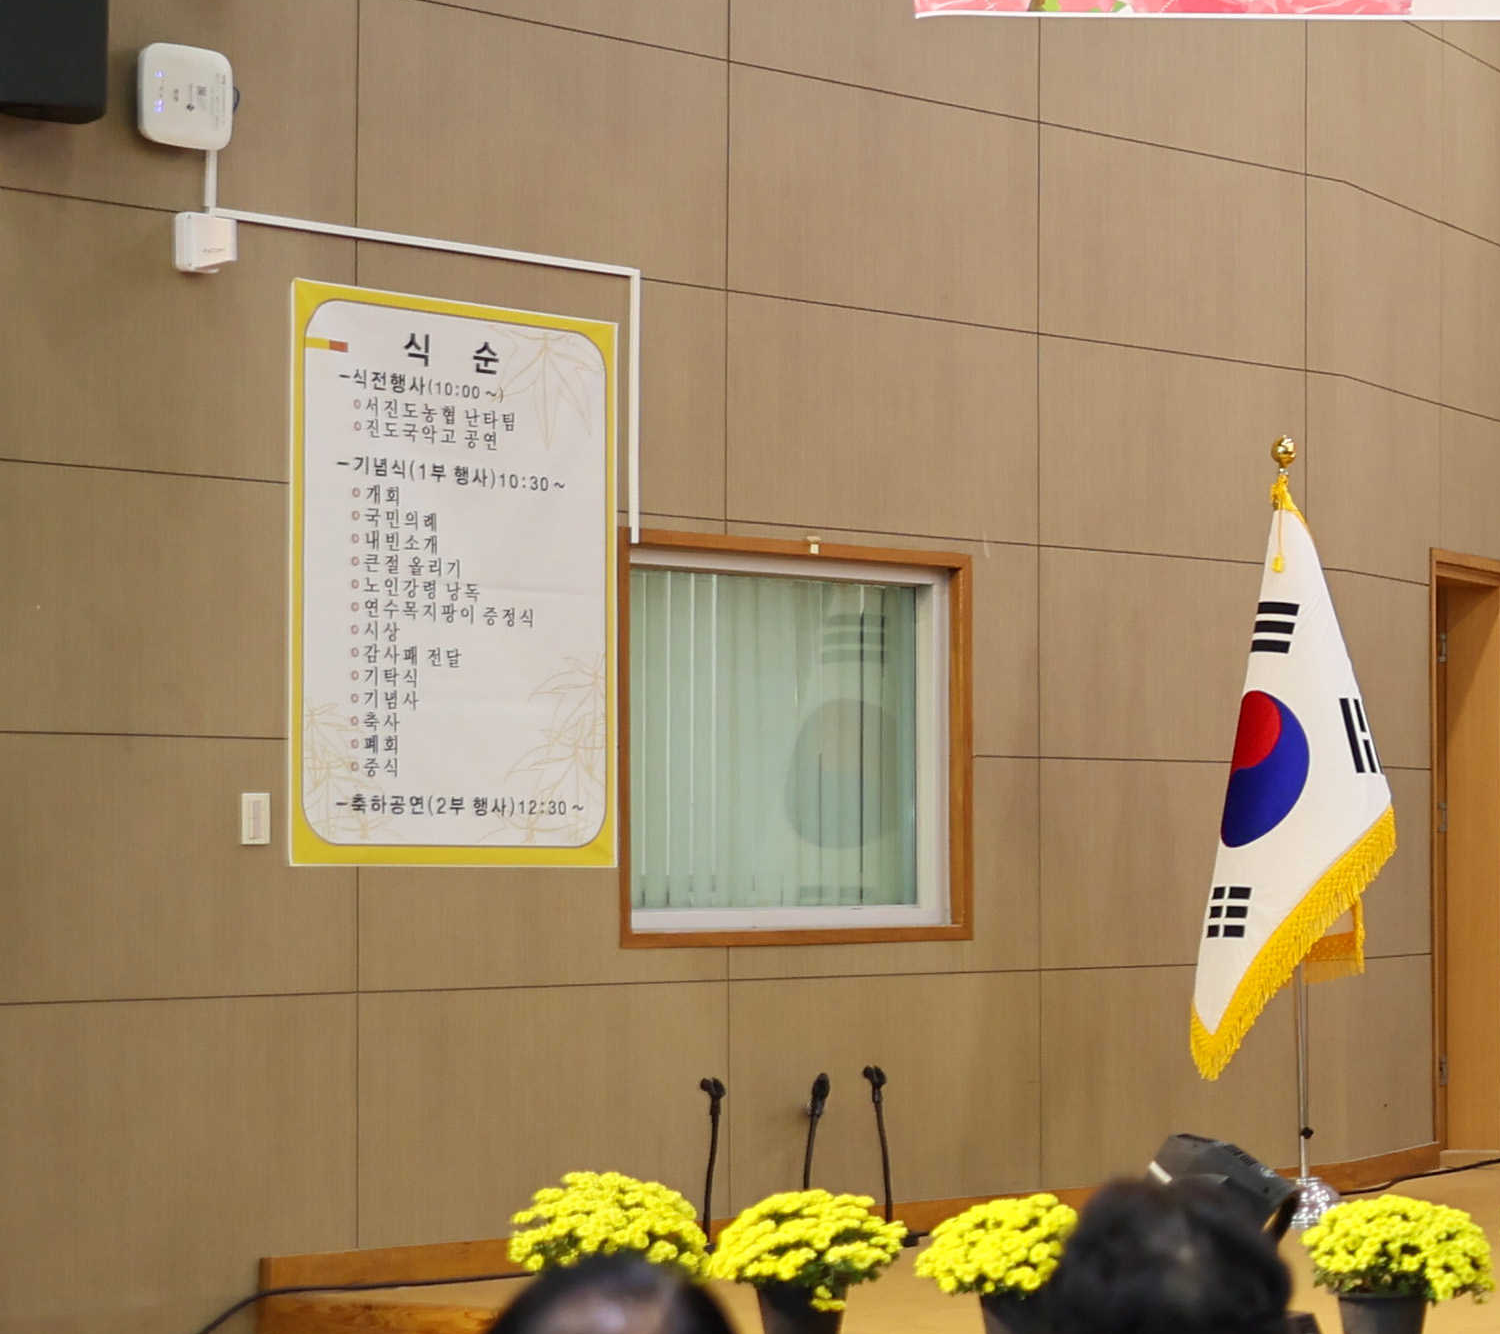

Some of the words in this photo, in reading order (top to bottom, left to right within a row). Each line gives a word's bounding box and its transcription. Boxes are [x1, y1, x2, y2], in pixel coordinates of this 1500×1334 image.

[365, 397, 456, 426] 서진도농협
[464, 408, 516, 432] 난타팀
[366, 419, 456, 445] 진도국악고
[464, 429, 499, 452] 공연
[366, 484, 400, 506] 개회
[364, 507, 438, 533] 국민의례
[365, 530, 438, 556] 내빈소개
[364, 553, 400, 574] 큰절
[408, 555, 461, 579] 올리기
[363, 576, 437, 599] 노인강령
[446, 581, 481, 603] 낭독
[364, 597, 475, 625] 연수목지팡이
[483, 606, 534, 629] 증정식
[363, 620, 400, 642] 시상
[364, 643, 418, 667] 감사패
[427, 647, 462, 668] 전달
[364, 666, 418, 688] 기탁식
[364, 689, 419, 711] 기념사
[364, 712, 400, 733] 축사
[364, 757, 398, 778] 중식
